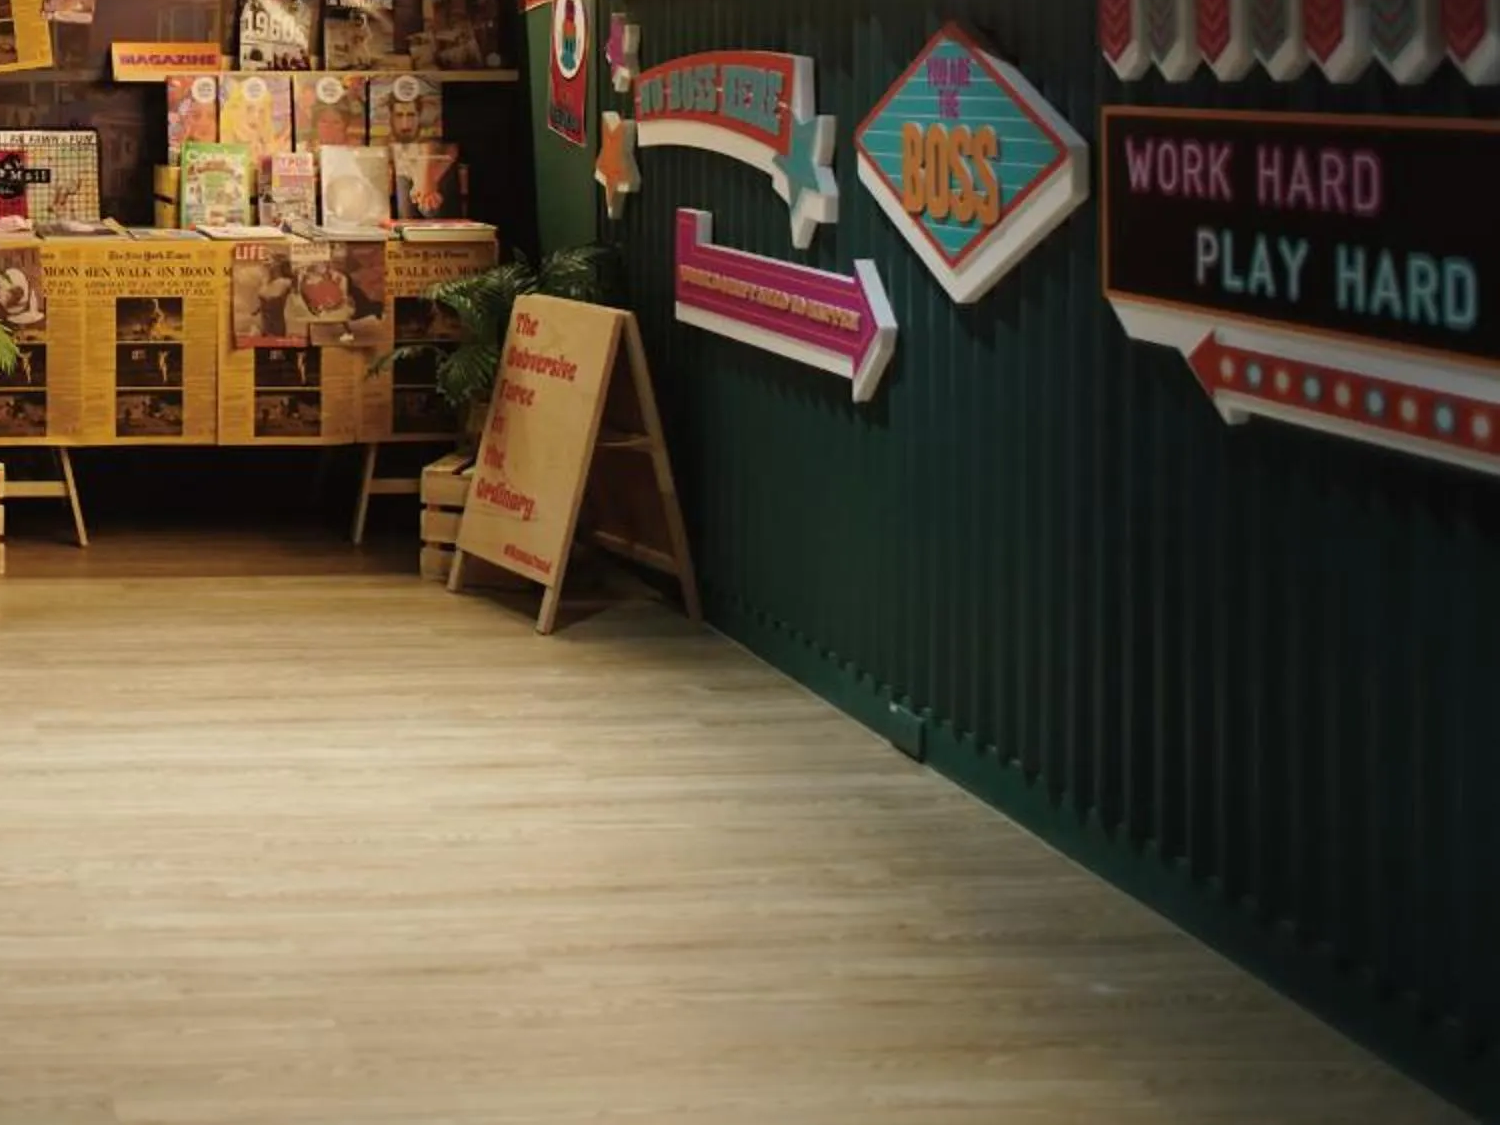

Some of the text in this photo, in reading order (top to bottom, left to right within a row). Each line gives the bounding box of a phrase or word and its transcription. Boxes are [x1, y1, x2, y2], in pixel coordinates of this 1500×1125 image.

[119, 53, 217, 66] MAGAZINE
[902, 122, 1000, 226] BOSS
[1123, 135, 1382, 217] WORK HARD
[235, 244, 267, 261] LIFE
[1195, 227, 1479, 330] PLAY HARD
[514, 311, 540, 337] The
